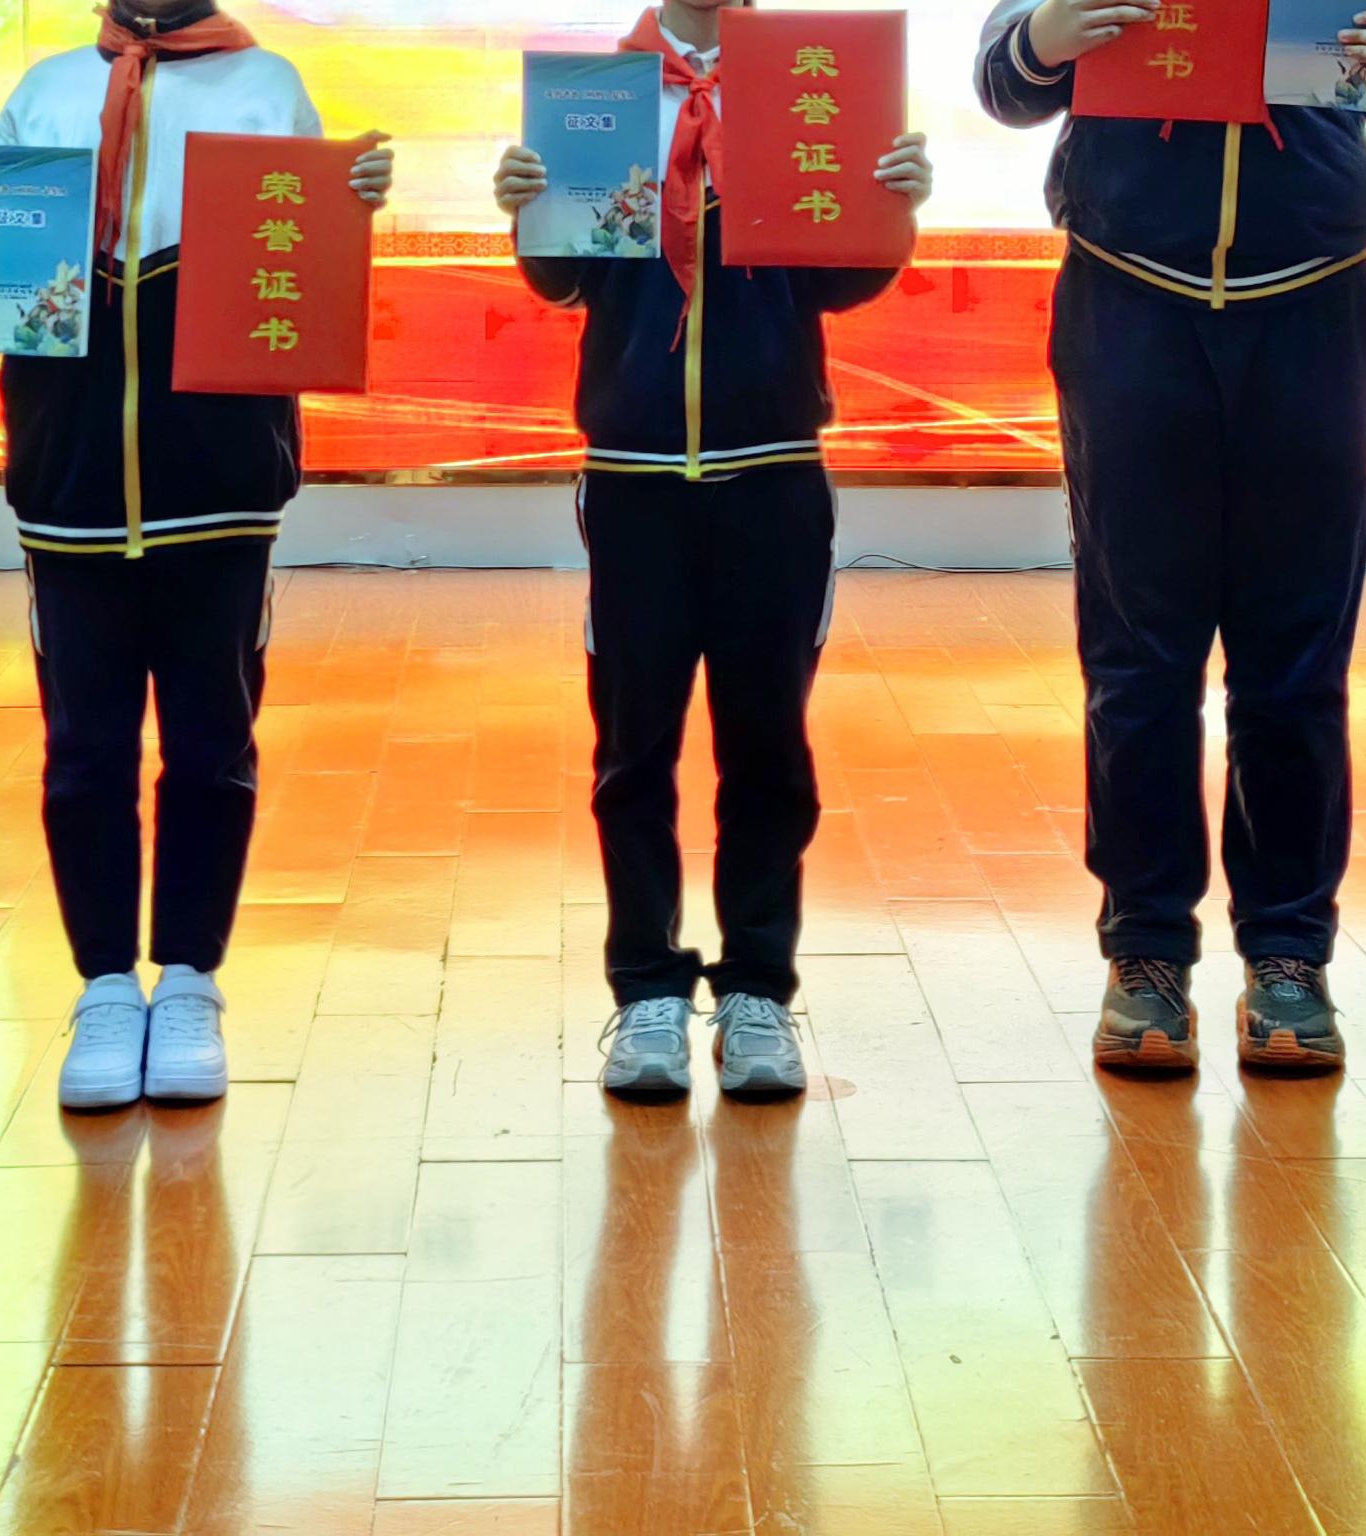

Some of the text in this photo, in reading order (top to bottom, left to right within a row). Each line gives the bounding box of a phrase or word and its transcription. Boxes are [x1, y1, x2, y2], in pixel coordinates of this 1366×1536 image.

[790, 46, 842, 224] 荣誉证书
[248, 171, 306, 353] 荣誉证书
